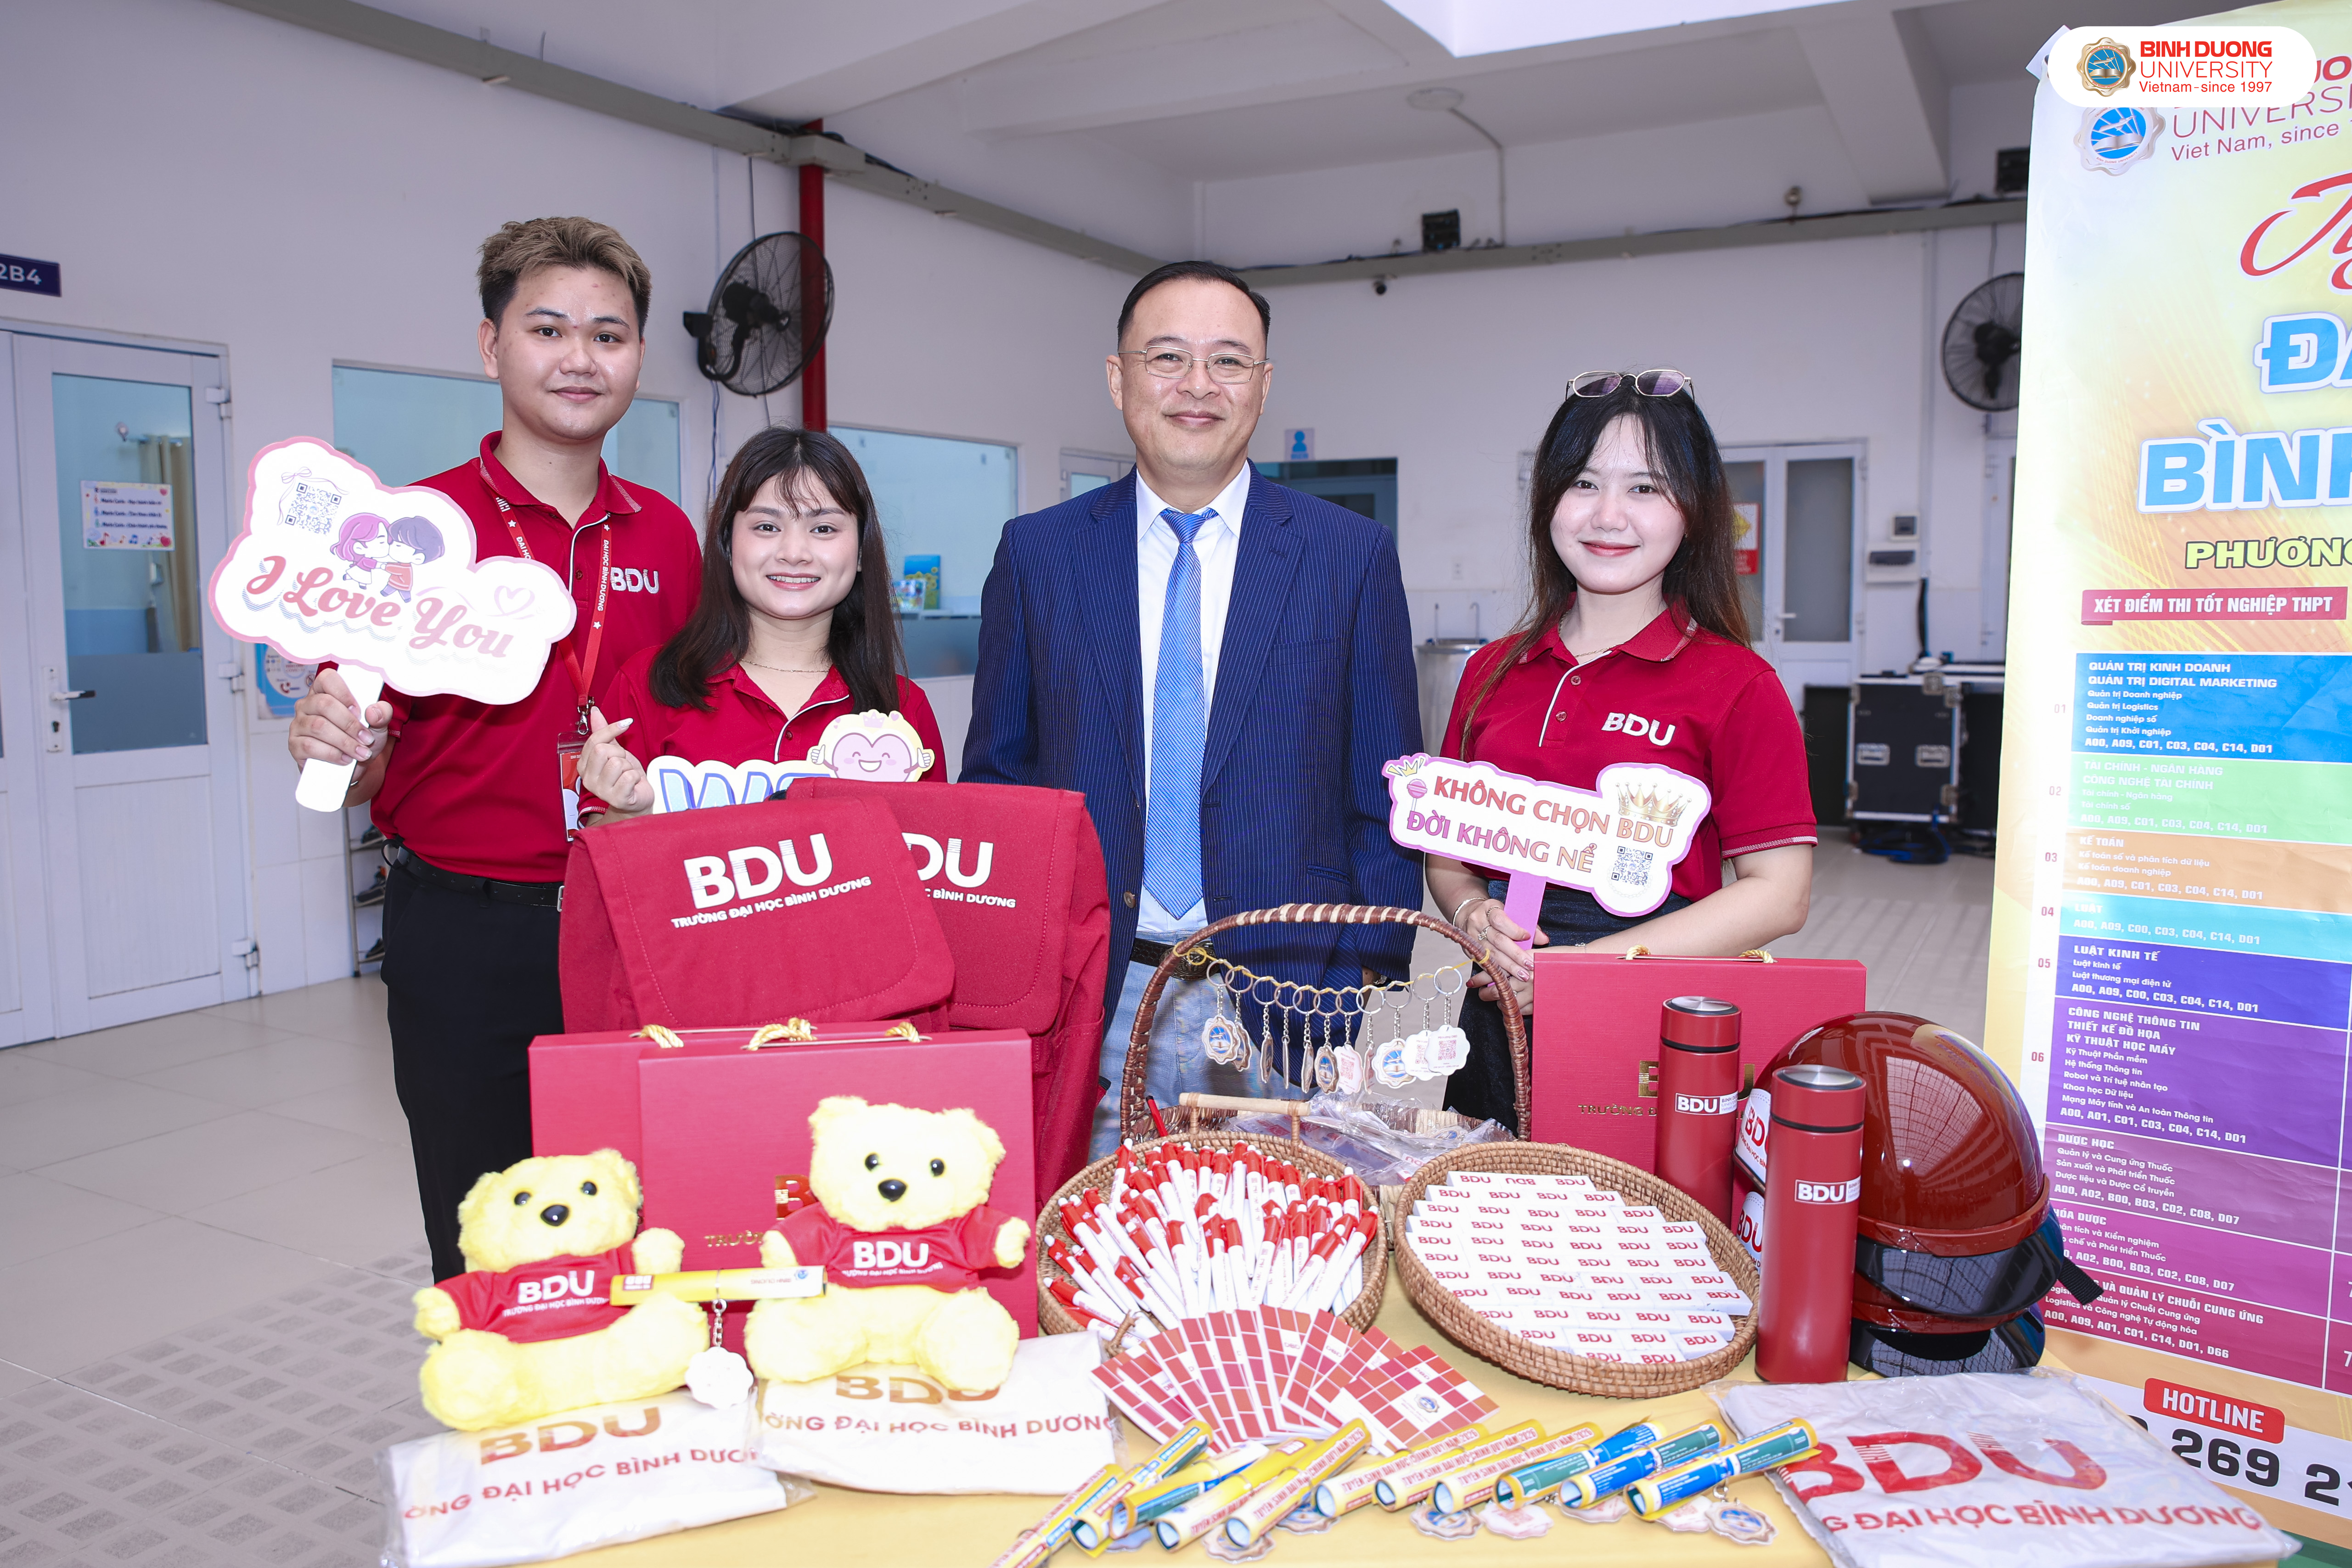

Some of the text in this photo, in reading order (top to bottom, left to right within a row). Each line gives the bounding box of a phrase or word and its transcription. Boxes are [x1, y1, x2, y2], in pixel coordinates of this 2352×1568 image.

[2171, 124, 2339, 161] Viet Nam, since
[610, 567, 659, 594] BDU
[597, 584, 607, 611] DƯƠNG
[2094, 593, 2333, 615] XÉT ĐIỂM THI TỐT NGHIỆP THPT
[283, 567, 401, 627] Love
[409, 597, 515, 658] You
[2089, 660, 2230, 673] QUẢN TRỊ KINH DOANH
[2088, 674, 2277, 688] QUẢN TRỊ DIGITAL MARKETING
[2152, 691, 2182, 700] nghiệp
[2054, 703, 2066, 713] 01
[1601, 712, 1676, 747] BDU
[2085, 738, 2272, 753] A00, A09, C01, C03, C04, C14, D01
[2049, 786, 2061, 796] 02
[1433, 776, 1674, 848] KHÔNG CHỌN BDU
[1407, 809, 1598, 873] ĐỜI KHÔNG NỂ
[683, 832, 833, 909] BDU
[670, 876, 872, 929] TRƯỜNG ĐẠI HỌC BÌNH DƯƠNG
[932, 888, 1017, 908] BÌNH DƯƠNG
[2038, 958, 2050, 968] 05
[2074, 945, 2161, 961] LUẬT KINH TẾ
[2068, 1007, 2200, 1031] CÔNG NGHỆ THÔNG TIN
[2031, 1052, 2044, 1062] 06
[2064, 1071, 2088, 1080] Robot
[2130, 1080, 2151, 1089] nhân
[2153, 1083, 2168, 1092] tạo
[1577, 1103, 1644, 1117] TRƯỜNG
[1677, 1096, 1718, 1113] BDU
[2057, 1147, 2080, 1157] Quản
[2104, 1154, 2127, 1165] Cung
[2129, 1158, 2145, 1169] ứng
[2147, 1162, 2173, 1172] Thuốc
[1460, 1175, 1492, 1184] BDU
[1798, 1183, 1845, 1202] BDU
[1622, 1209, 1654, 1218] BDU
[853, 1241, 929, 1269] BDU
[1666, 1242, 1698, 1250] BDU
[518, 1270, 595, 1304] BDU
[1534, 1310, 1569, 1319] BDU
[2103, 1281, 2264, 1324] VÀ QUẢN LÝ CHUỖI CUNG ỨNG
[2044, 1309, 2229, 1359] A00, A09, A01, C01, C14, D01, D66
[2162, 1387, 2264, 1433] HOTLINE
[479, 1407, 661, 1465] BDU
[834, 1415, 879, 1435] ĐẠI
[889, 1418, 949, 1434] HỌC
[958, 1417, 1017, 1439] BÌNH
[2171, 1428, 2280, 1488] 269
[482, 1476, 531, 1502] ĐẠI
[543, 1464, 606, 1495] HỌC
[616, 1451, 681, 1476] BÌNH
[1854, 1499, 2264, 1539] ĐẠI HỌC BÌNH DƯƠNG
